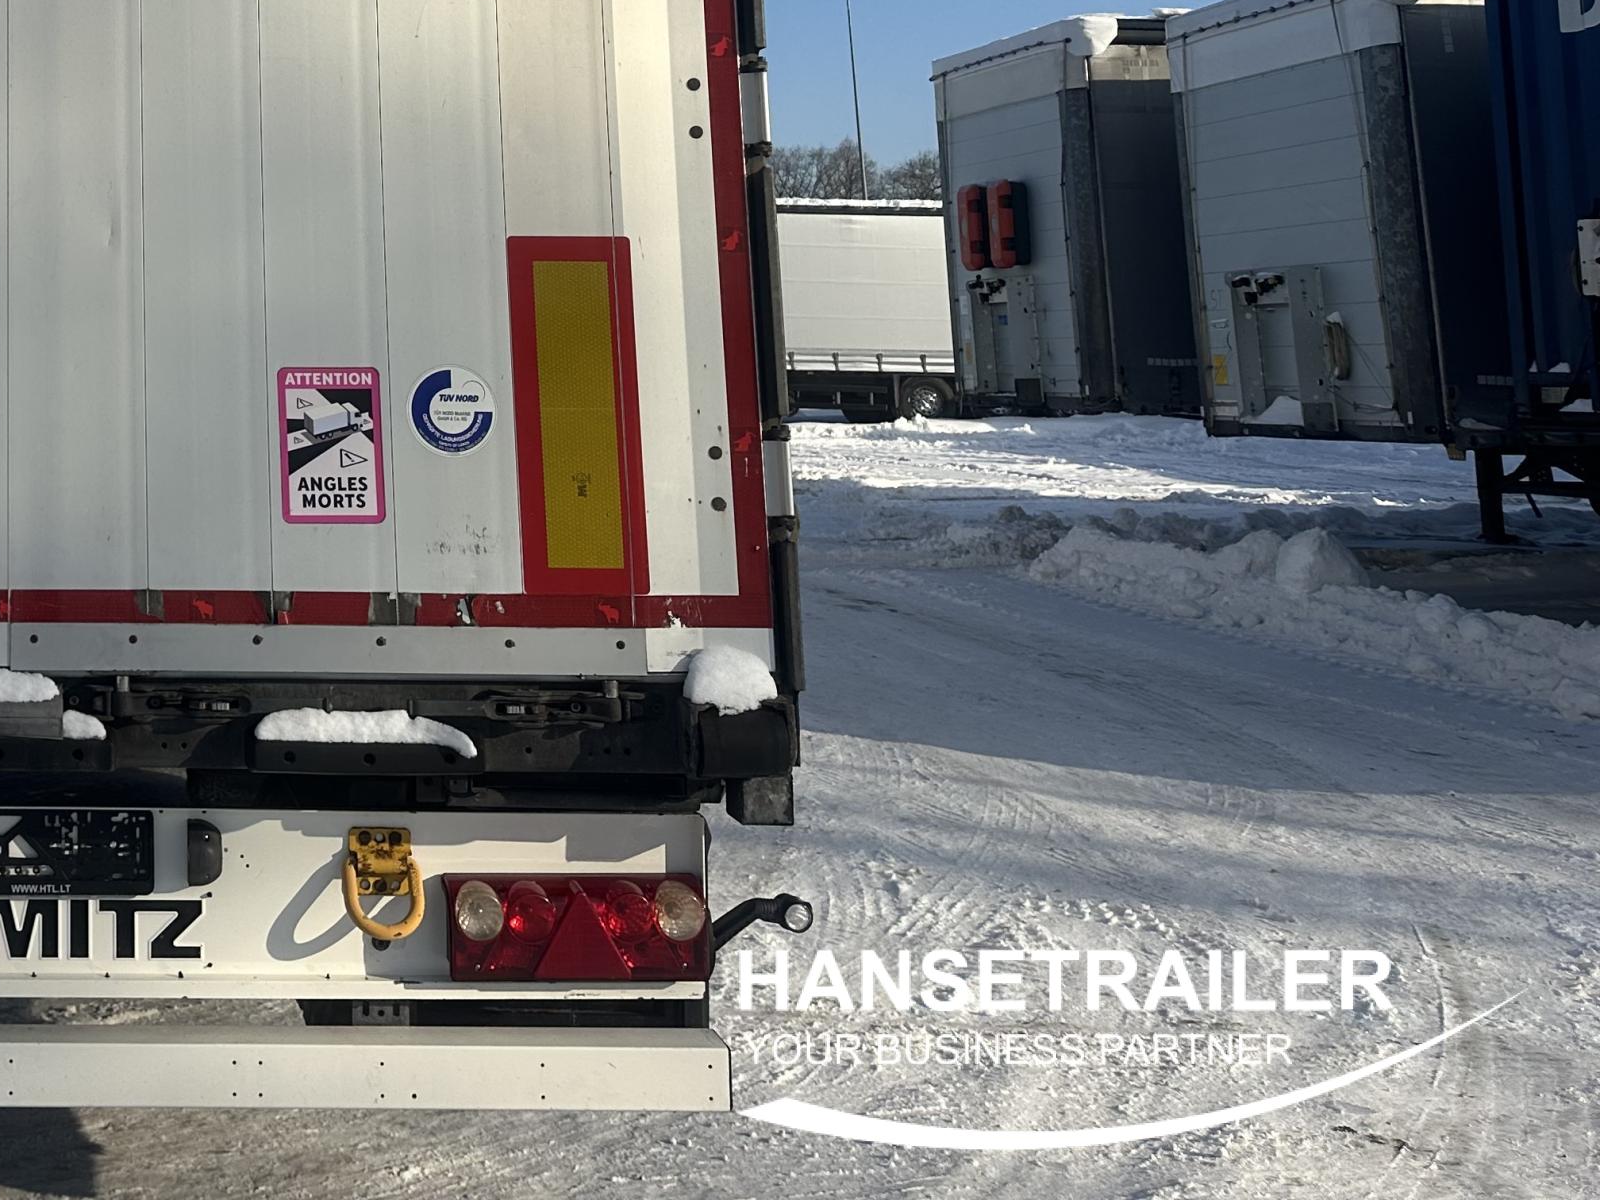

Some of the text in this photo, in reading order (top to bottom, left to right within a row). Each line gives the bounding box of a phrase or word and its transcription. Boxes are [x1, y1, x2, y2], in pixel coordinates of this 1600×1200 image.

[284, 372, 372, 386] ATTENTION
[455, 394, 479, 402] NORD
[297, 476, 368, 492] ANGLES
[302, 493, 366, 509] MORTS
[11, 884, 71, 894] WWW.HTL.LT
